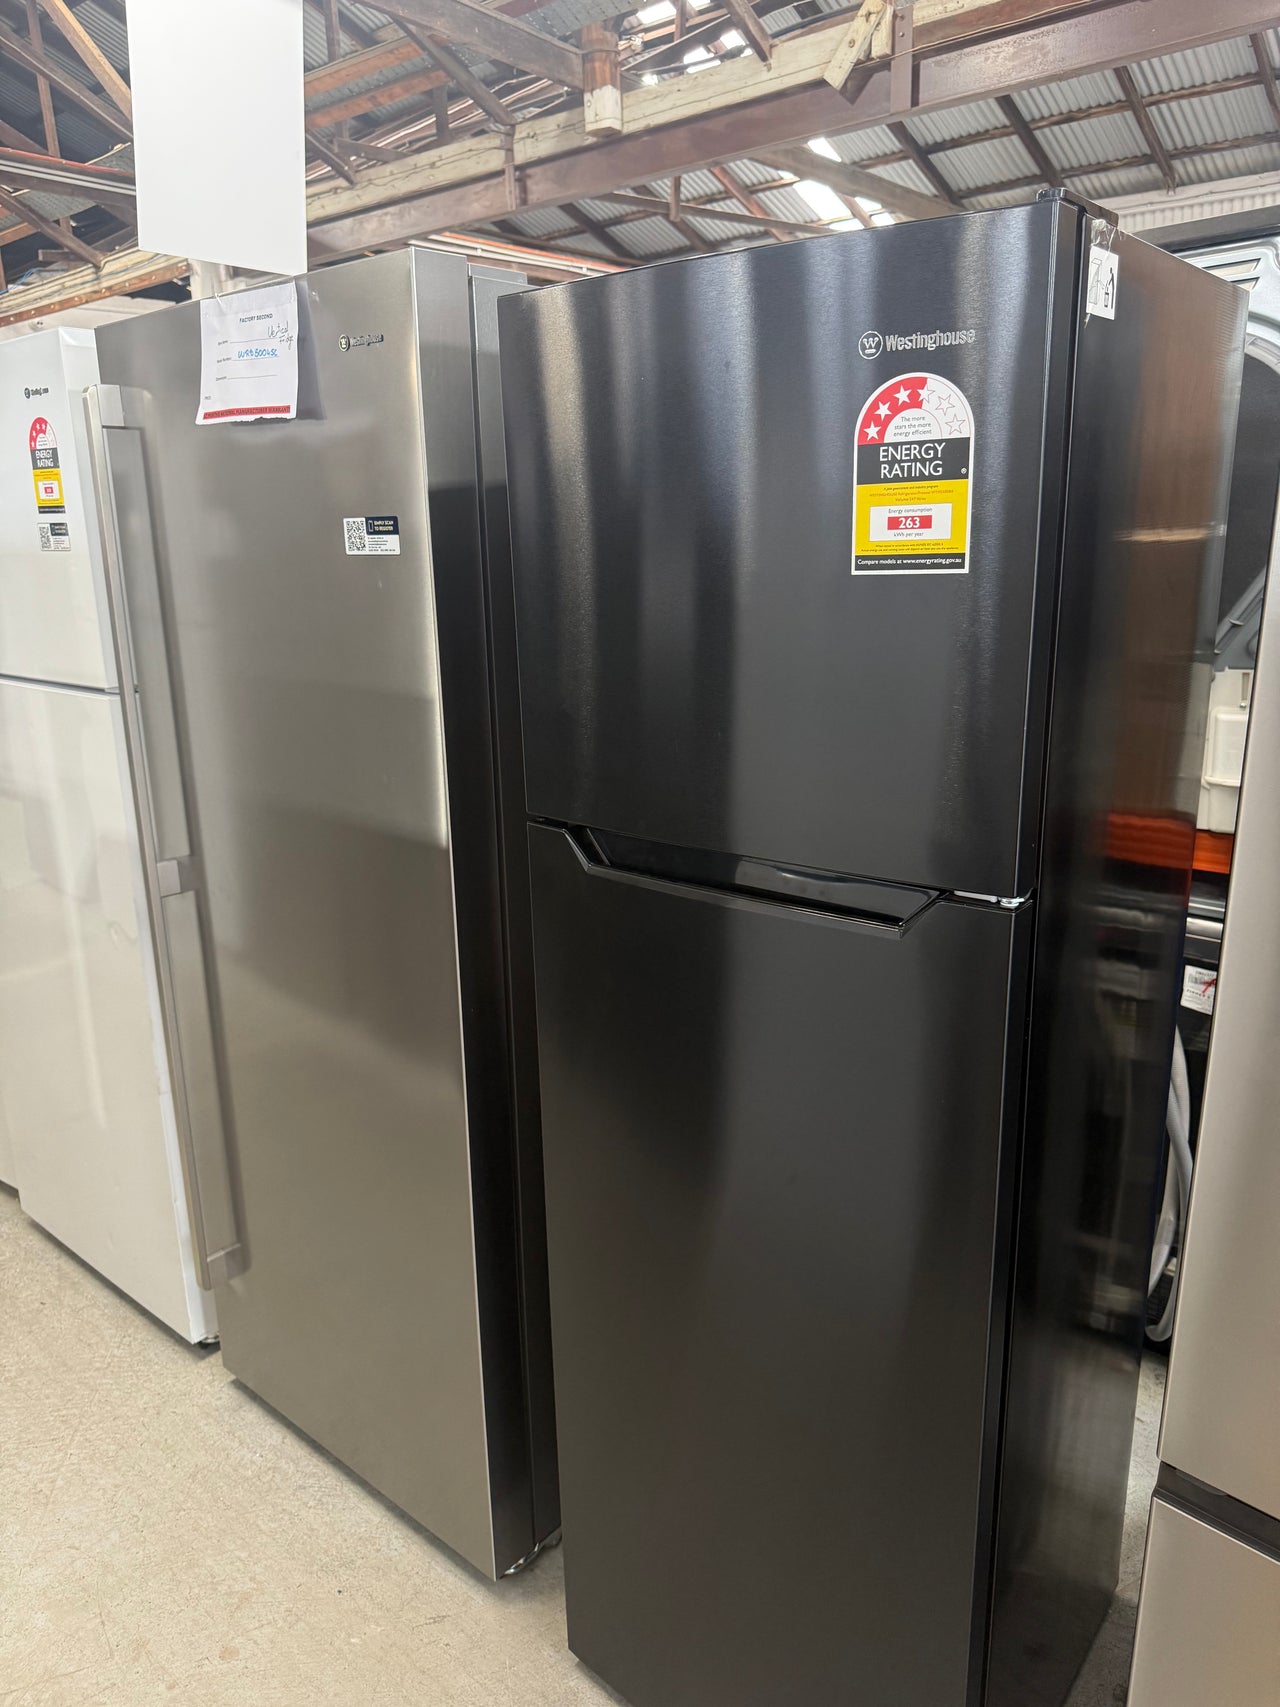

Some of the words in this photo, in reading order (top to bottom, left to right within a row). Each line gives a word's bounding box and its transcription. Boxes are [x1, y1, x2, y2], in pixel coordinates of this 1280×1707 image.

[885, 329, 976, 352] Westinghouse
[880, 442, 946, 462] ENERGY
[880, 461, 943, 479] RATING
[898, 516, 920, 529] 263
[902, 557, 962, 565] www.energyrating.gov.au
